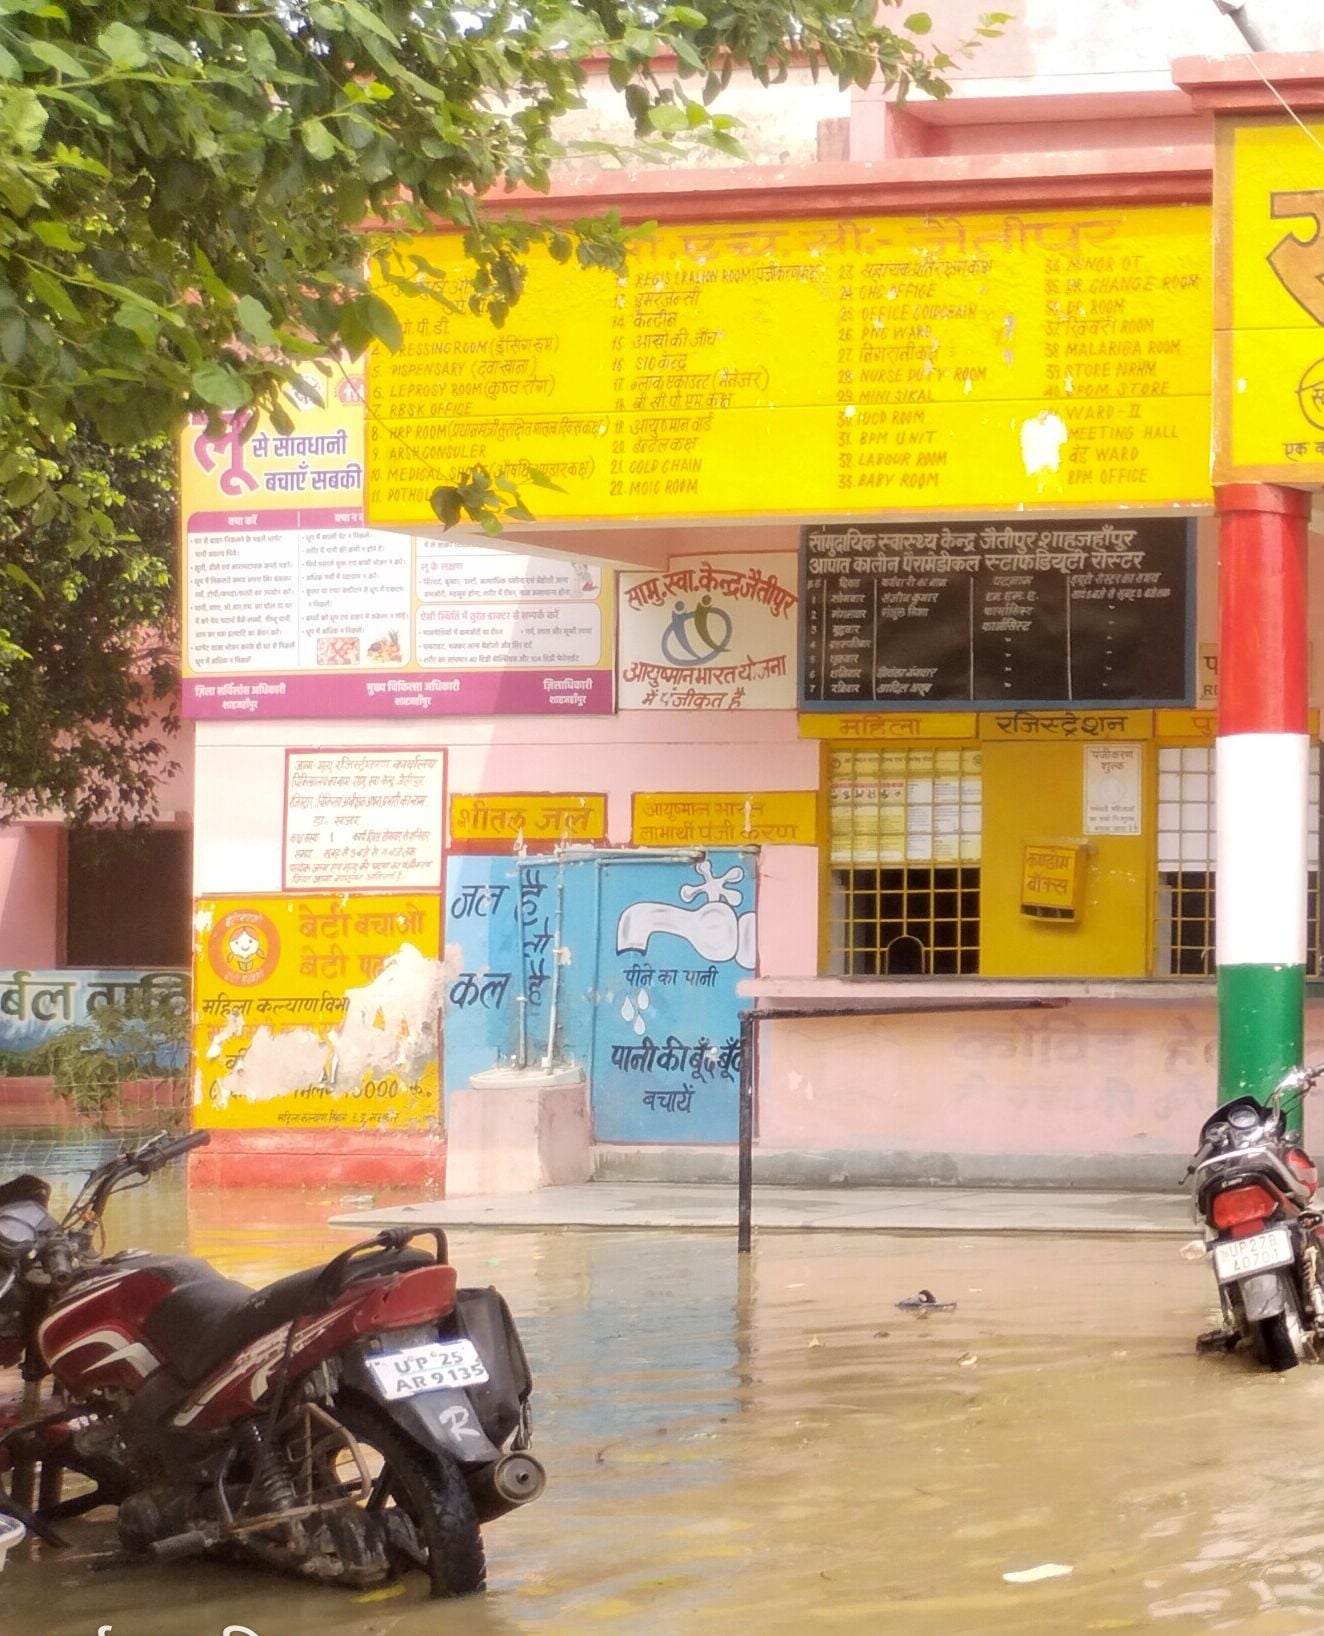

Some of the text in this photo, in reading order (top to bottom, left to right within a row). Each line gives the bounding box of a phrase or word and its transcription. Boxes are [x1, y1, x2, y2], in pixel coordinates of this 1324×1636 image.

[860, 369, 901, 383] NURSE
[430, 402, 473, 415] OFFICE
[896, 431, 937, 445] UNIT
[1144, 425, 1179, 439] HALL
[252, 429, 348, 458] से सावधानी
[1095, 447, 1138, 461] WARD
[1282, 442, 1308, 462] एक
[662, 458, 703, 474] CHAIN
[858, 452, 947, 466] LABOUR ROOM
[264, 461, 309, 492] बचाएँ
[387, 465, 449, 481] MEDICAL
[900, 472, 939, 489] ROOM
[1101, 468, 1149, 484] OFFICE
[665, 478, 699, 494] ROOM
[809, 526, 1137, 558] सामुदायिक स्वास्थ्य केन्द्र जैतीपुर शाहजहाँपुर
[852, 552, 899, 574] कालीन
[1091, 551, 1146, 571] रोस्टर
[424, 679, 461, 693] अधिकारी
[695, 666, 738, 685] भारत
[642, 686, 745, 709] में है
[839, 713, 922, 737] महिला
[995, 711, 1130, 737] रजिस्ट्रेशन
[458, 801, 525, 831] शीतल
[534, 805, 595, 834] जल
[452, 883, 509, 921] जल
[298, 903, 352, 939] बेटी
[354, 902, 427, 937] बचाओ
[299, 943, 350, 979] बेटी
[450, 960, 551, 1010] कल है
[624, 962, 719, 988] पीने का पानी
[202, 992, 318, 1016] महिला कल्याण
[611, 1036, 657, 1074] पानी
[657, 1037, 687, 1073] की
[394, 1351, 464, 1373] UP 25
